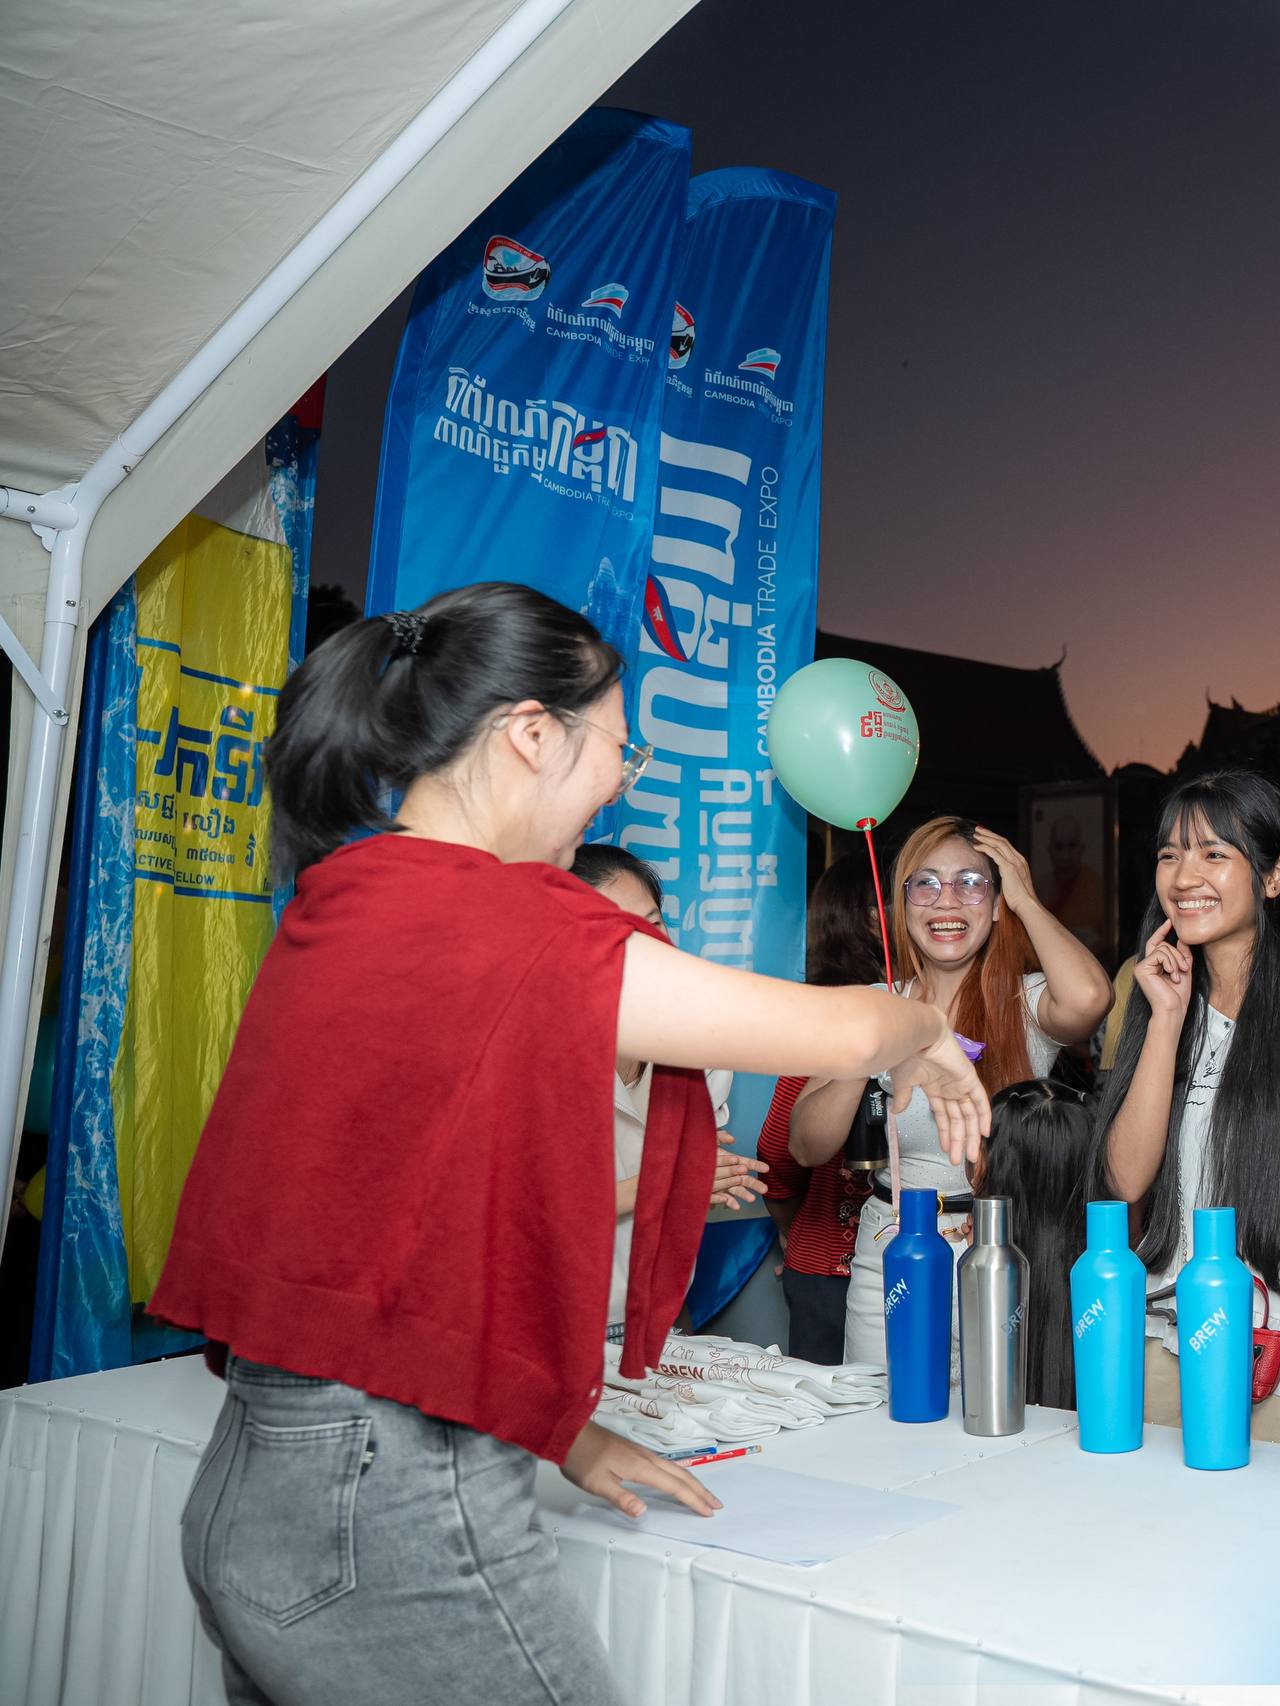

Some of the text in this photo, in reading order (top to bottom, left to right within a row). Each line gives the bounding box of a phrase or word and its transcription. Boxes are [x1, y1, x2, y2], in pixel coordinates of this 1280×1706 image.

[546, 327, 602, 347] CAMBODIA
[704, 390, 756, 409] CAMBODIA
[543, 479, 593, 501] CAMBODIA
[759, 466, 778, 529] EXPO
[757, 541, 776, 616] TRADE
[174, 869, 215, 886] ELLOW
[884, 1278, 908, 1316] BREW
[1074, 1298, 1104, 1338] BREW
[1188, 1306, 1228, 1352] BREW
